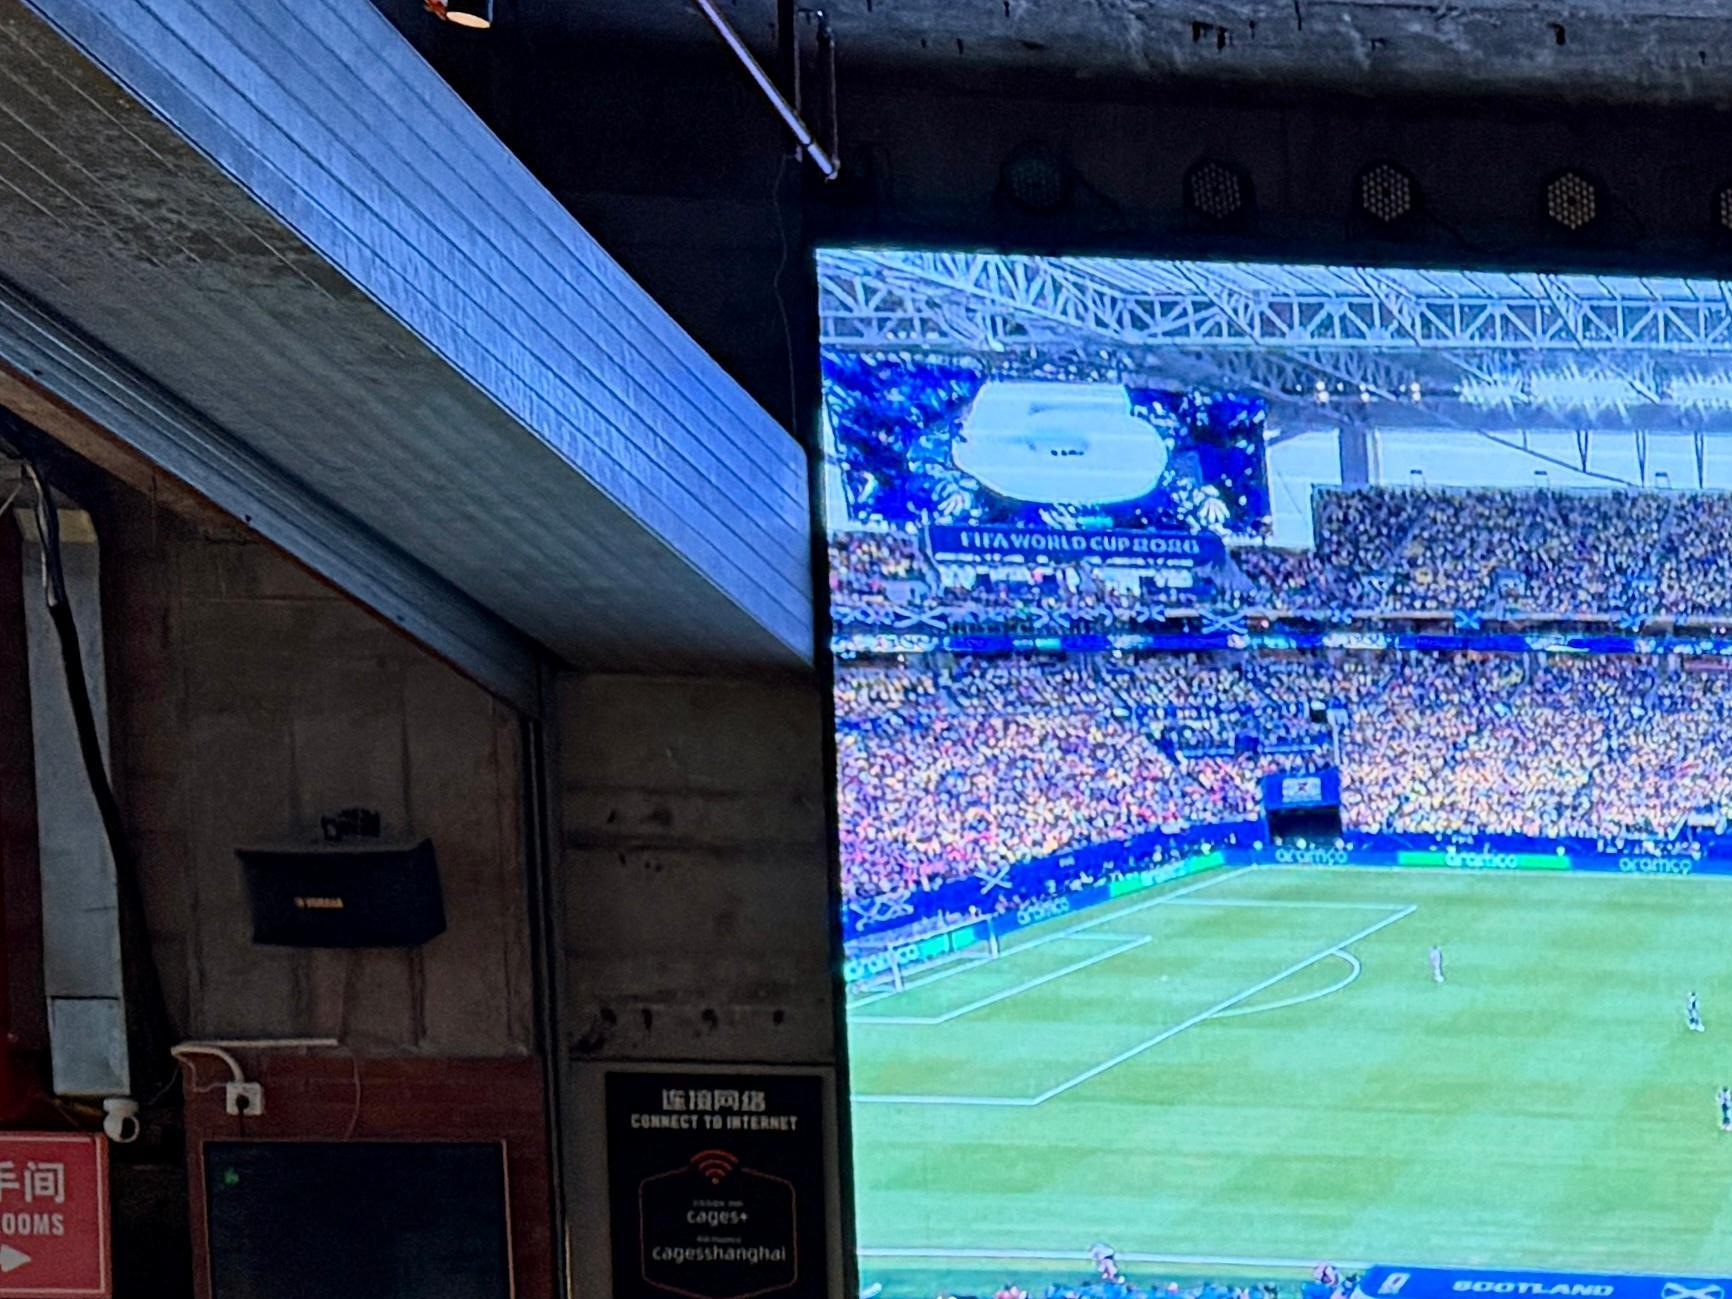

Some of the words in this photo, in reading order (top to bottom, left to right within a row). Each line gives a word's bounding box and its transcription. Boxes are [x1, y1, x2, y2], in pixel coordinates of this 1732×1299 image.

[630, 1113, 699, 1131] CONNECT
[704, 1114, 724, 1131] TO
[726, 1114, 799, 1132] INTERNET
[651, 1243, 787, 1265] cagesshanghai
